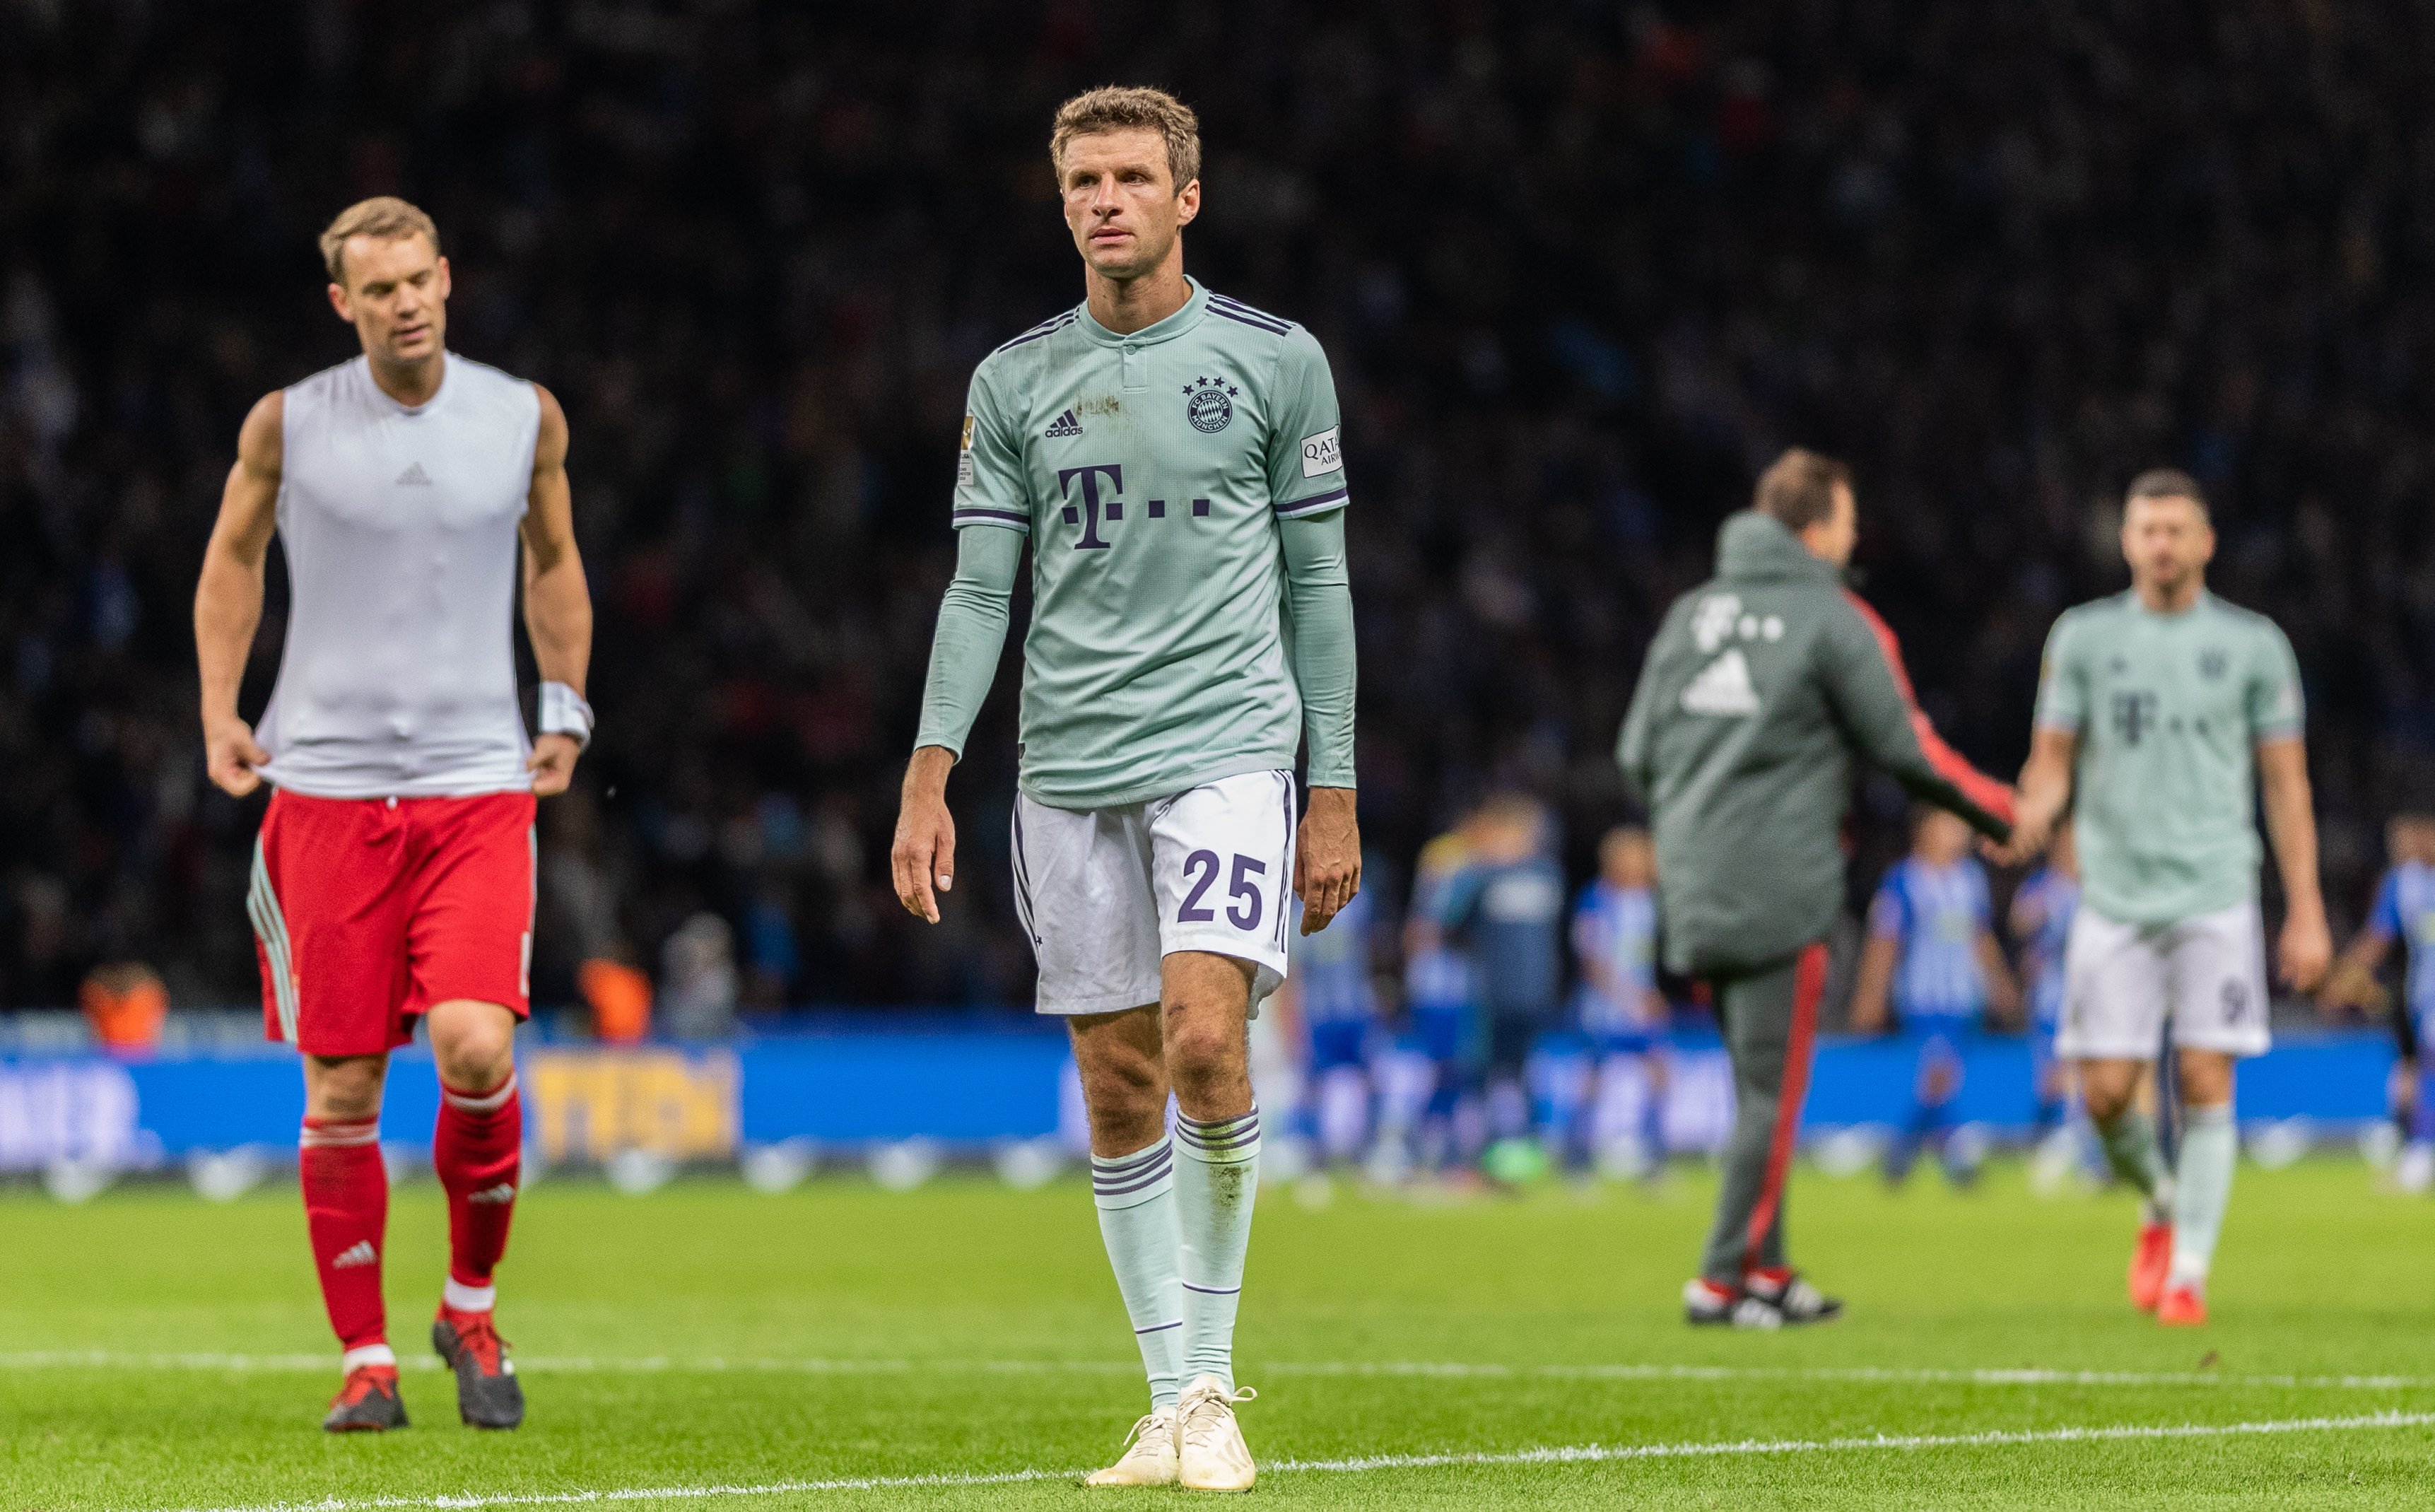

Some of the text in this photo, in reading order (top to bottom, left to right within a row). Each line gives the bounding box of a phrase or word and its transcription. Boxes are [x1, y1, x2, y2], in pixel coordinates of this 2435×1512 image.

[1192, 393, 1229, 409] FC BAYERN
[1045, 426, 1084, 438] adidas
[1304, 435, 1339, 460] QATA
[1178, 849, 1267, 932] 25
